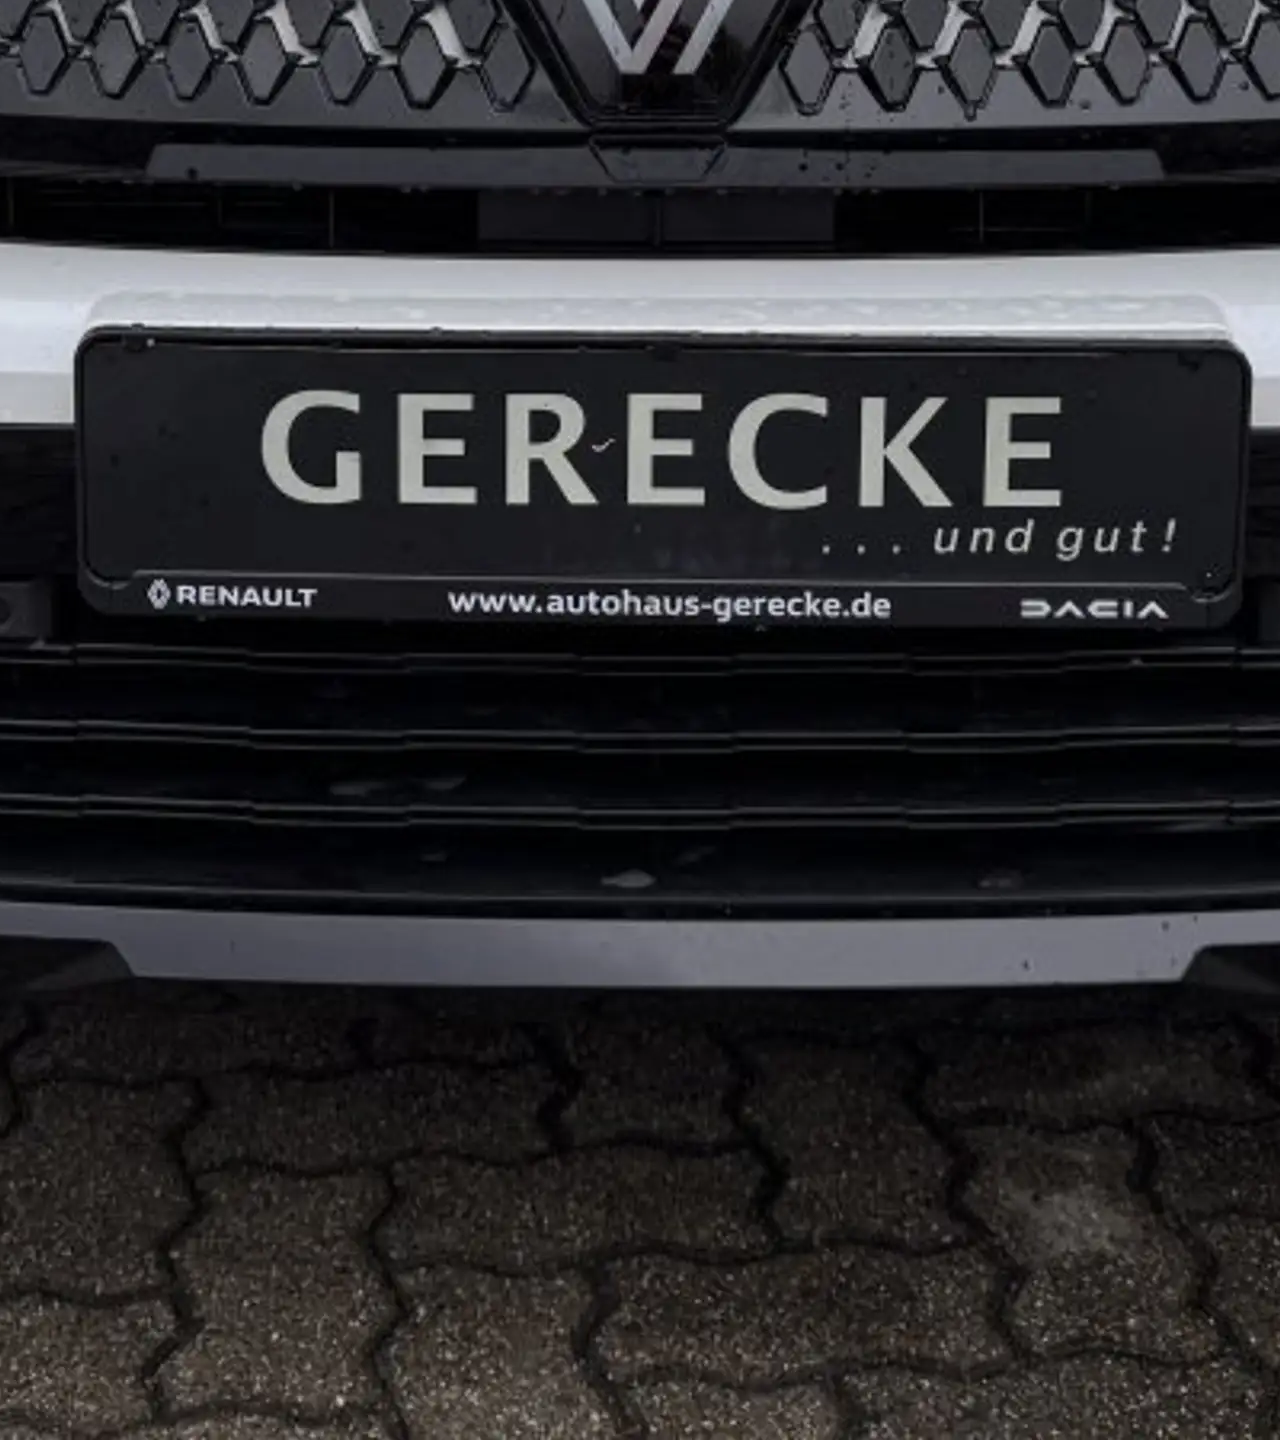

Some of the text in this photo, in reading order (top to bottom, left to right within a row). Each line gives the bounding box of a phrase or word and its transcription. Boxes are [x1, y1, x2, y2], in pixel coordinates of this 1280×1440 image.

[260, 389, 1062, 510] GERECKE
[933, 517, 1036, 554] und
[176, 583, 319, 608] RENAULT
[447, 587, 892, 623] www.autohaus-gerecke.de
[1020, 599, 1169, 619] DACIA
